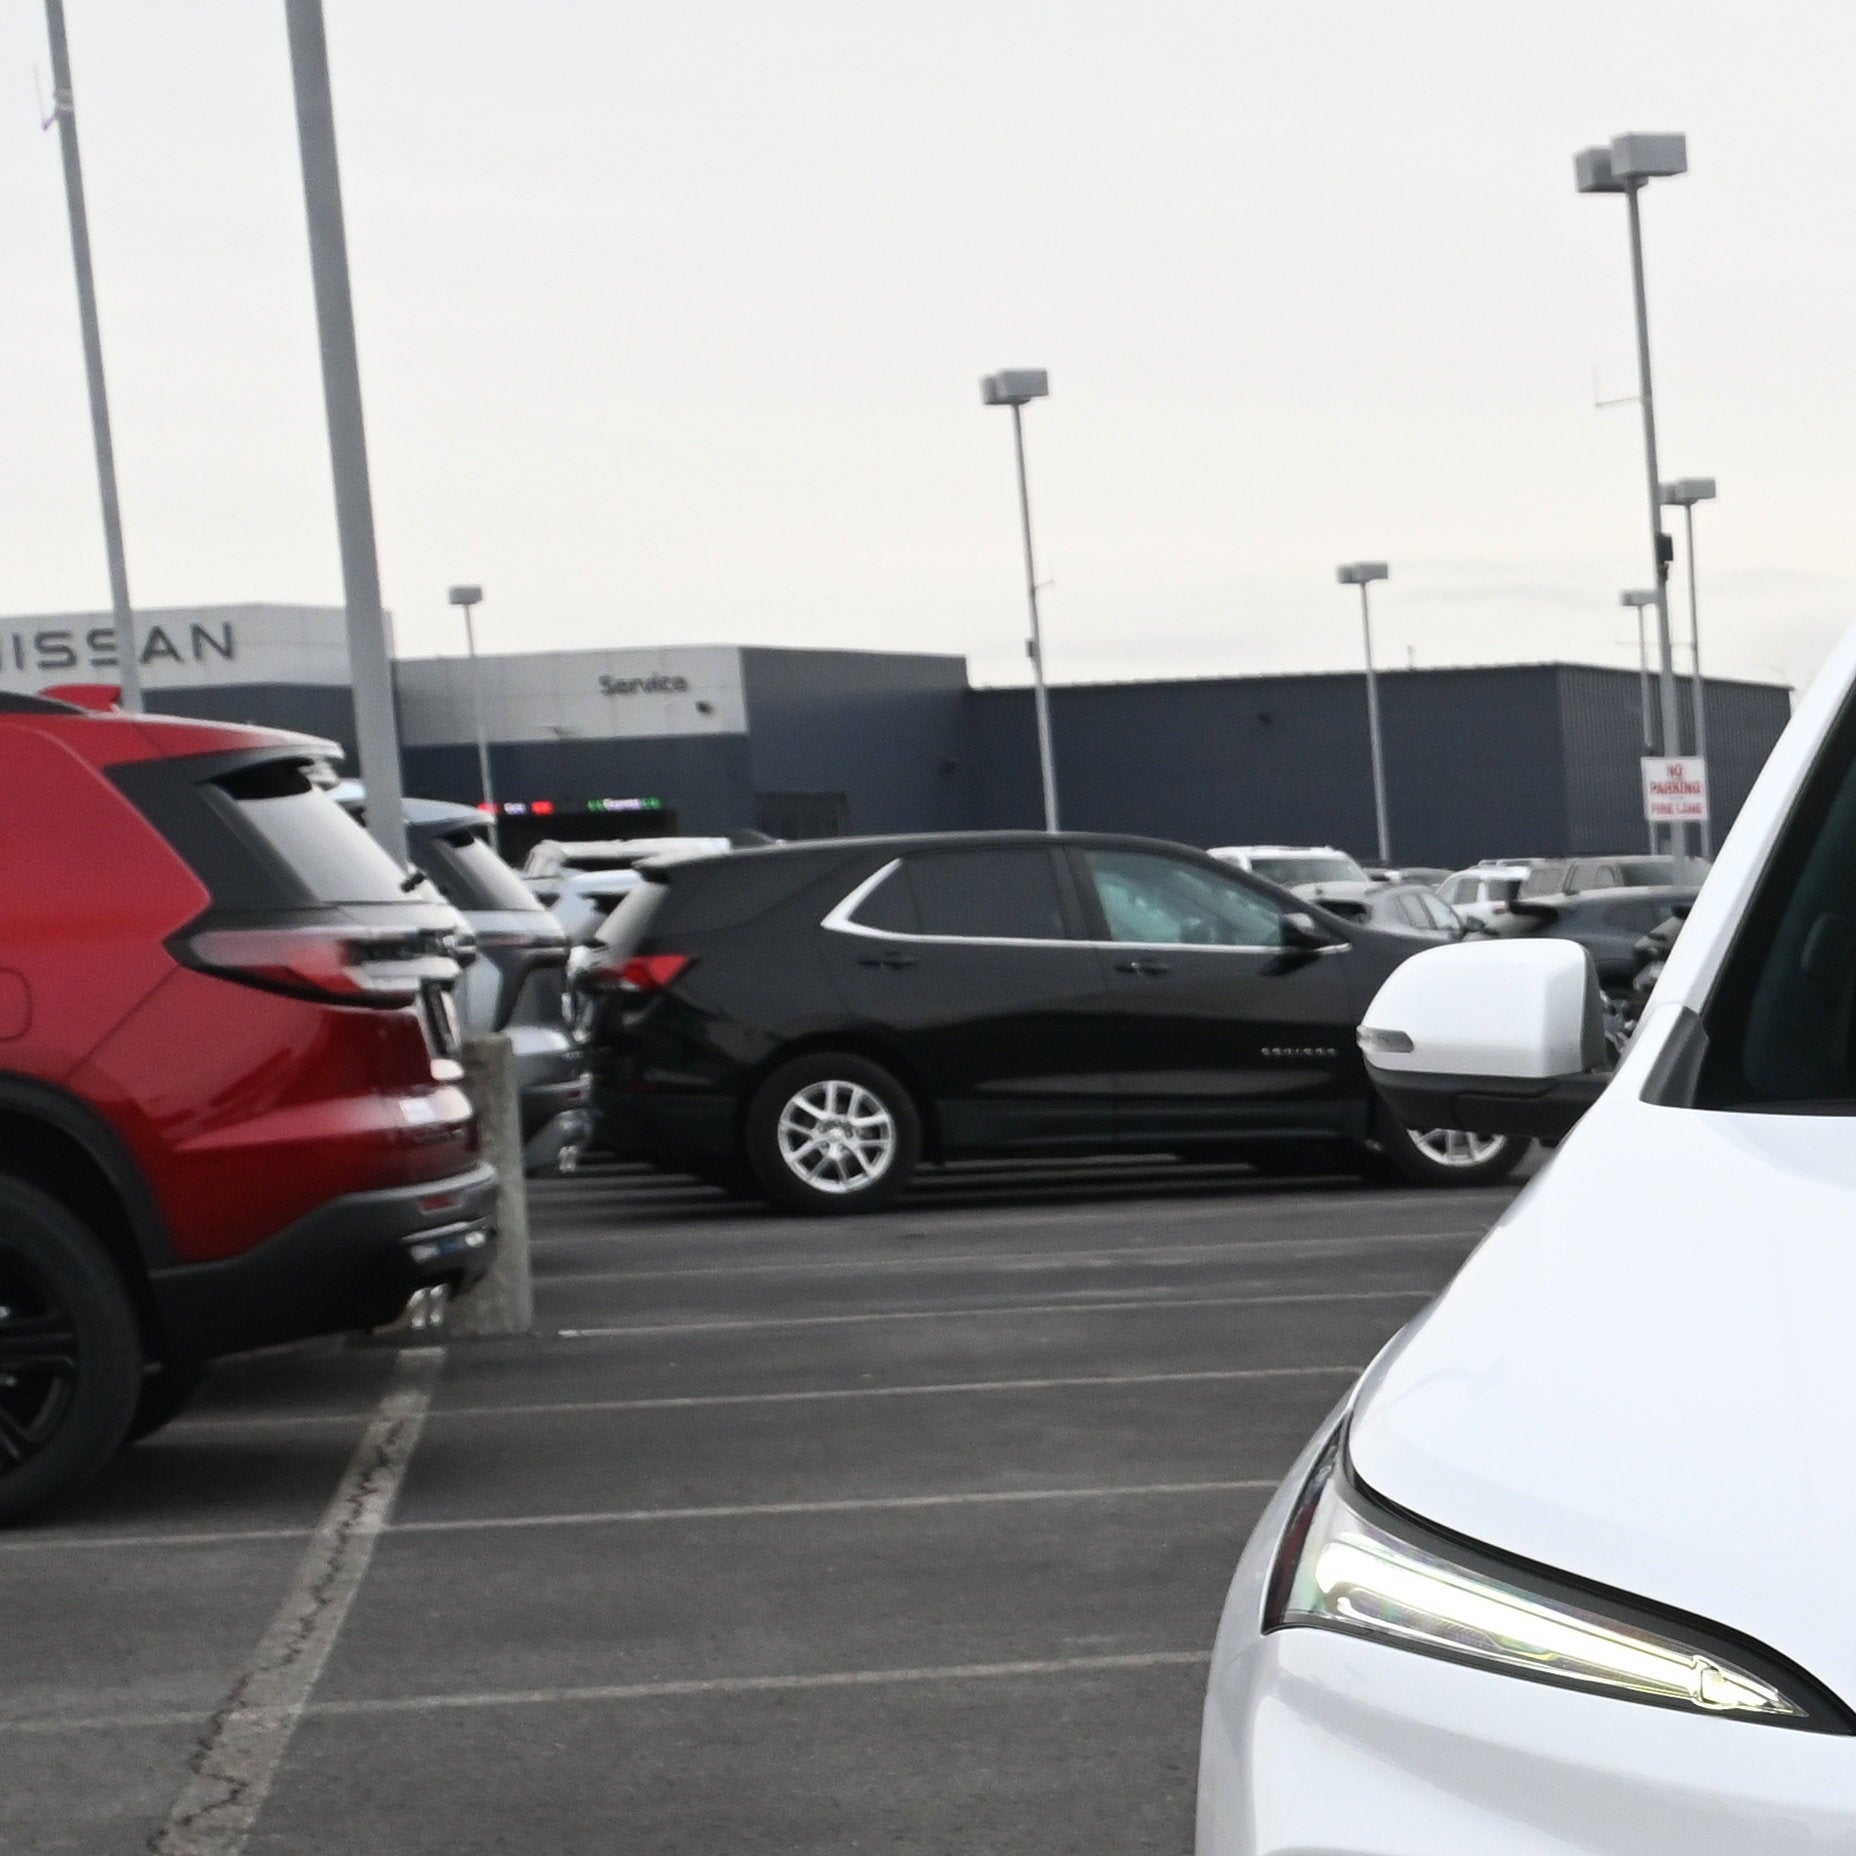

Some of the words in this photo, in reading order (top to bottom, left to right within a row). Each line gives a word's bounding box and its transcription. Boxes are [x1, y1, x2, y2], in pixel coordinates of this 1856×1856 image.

[0, 621, 236, 670] ISSAN
[599, 673, 689, 697] Service
[1667, 763, 1684, 777] NO
[1650, 780, 1701, 795] PARKING
